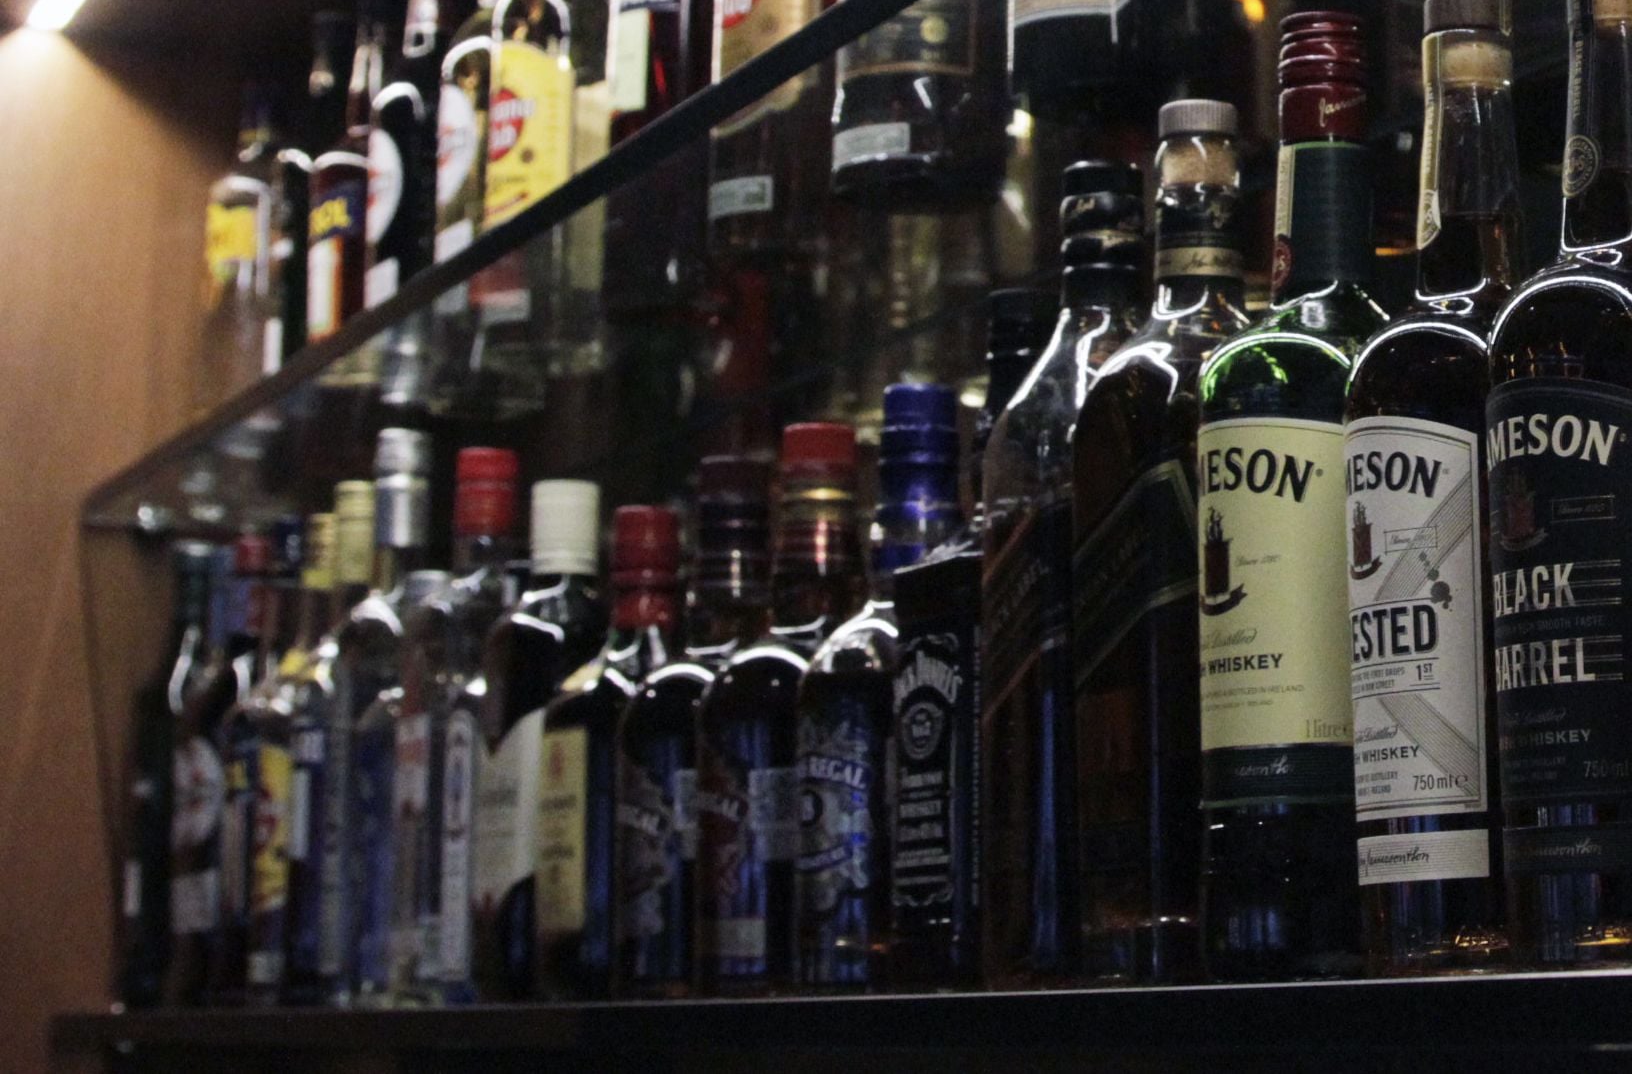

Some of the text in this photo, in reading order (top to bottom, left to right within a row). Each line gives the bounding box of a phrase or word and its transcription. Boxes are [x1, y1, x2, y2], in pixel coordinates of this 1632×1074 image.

[1486, 413, 1619, 472] MESON
[1200, 446, 1315, 504] ESON
[1493, 561, 1576, 618] BLACK
[1208, 653, 1284, 676] WHISKEY
[1362, 744, 1421, 763] WHISKEY
[1582, 759, 1609, 779] 750
[1412, 774, 1435, 793] 750
[1436, 773, 1455, 790] ml
